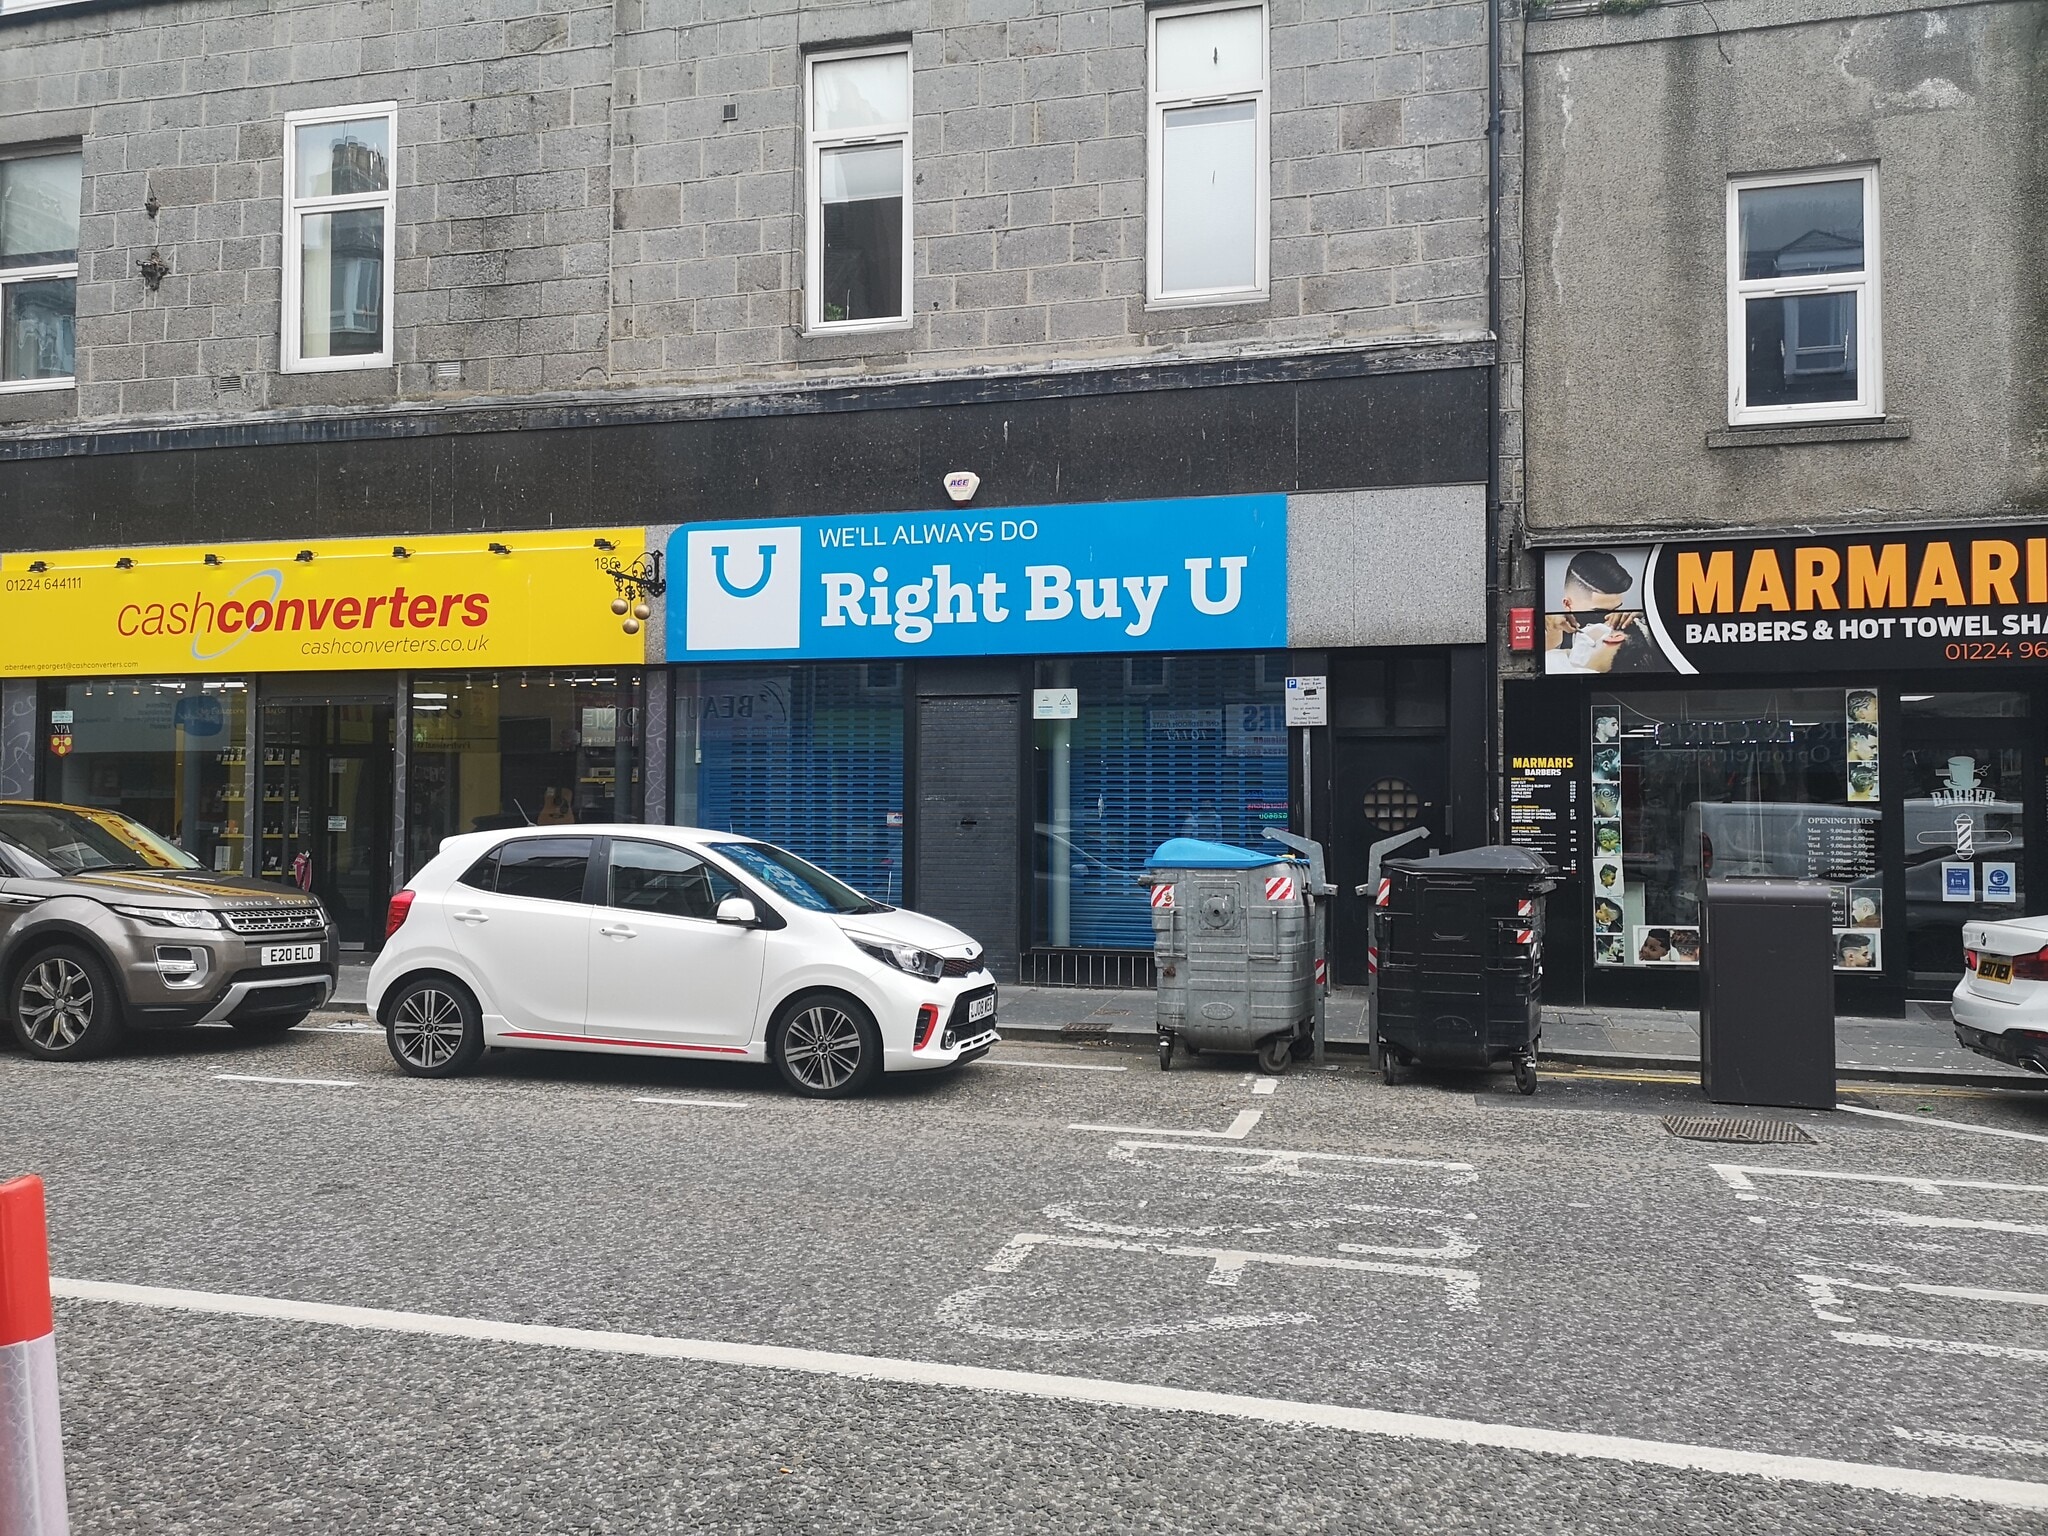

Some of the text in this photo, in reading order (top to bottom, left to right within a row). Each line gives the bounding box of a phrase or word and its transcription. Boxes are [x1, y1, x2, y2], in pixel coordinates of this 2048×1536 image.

[818, 519, 1039, 548] WE'LL ALWAYS DO
[594, 557, 618, 570] 186
[6, 577, 82, 592] 01224 644111
[820, 555, 1247, 644] Right Buy U
[1686, 620, 1808, 644] BARBERS
[1812, 619, 1834, 641] &
[1840, 618, 1897, 640] HOT
[1900, 615, 1998, 638] TOWEL
[301, 634, 489, 656] cashconverters.co.uk
[1945, 642, 2013, 660] 01224
[54, 724, 71, 734] NPA
[1512, 758, 1574, 768] MARMARIS
[1930, 789, 1996, 807] BARBER
[270, 947, 314, 962] E20 ELO
